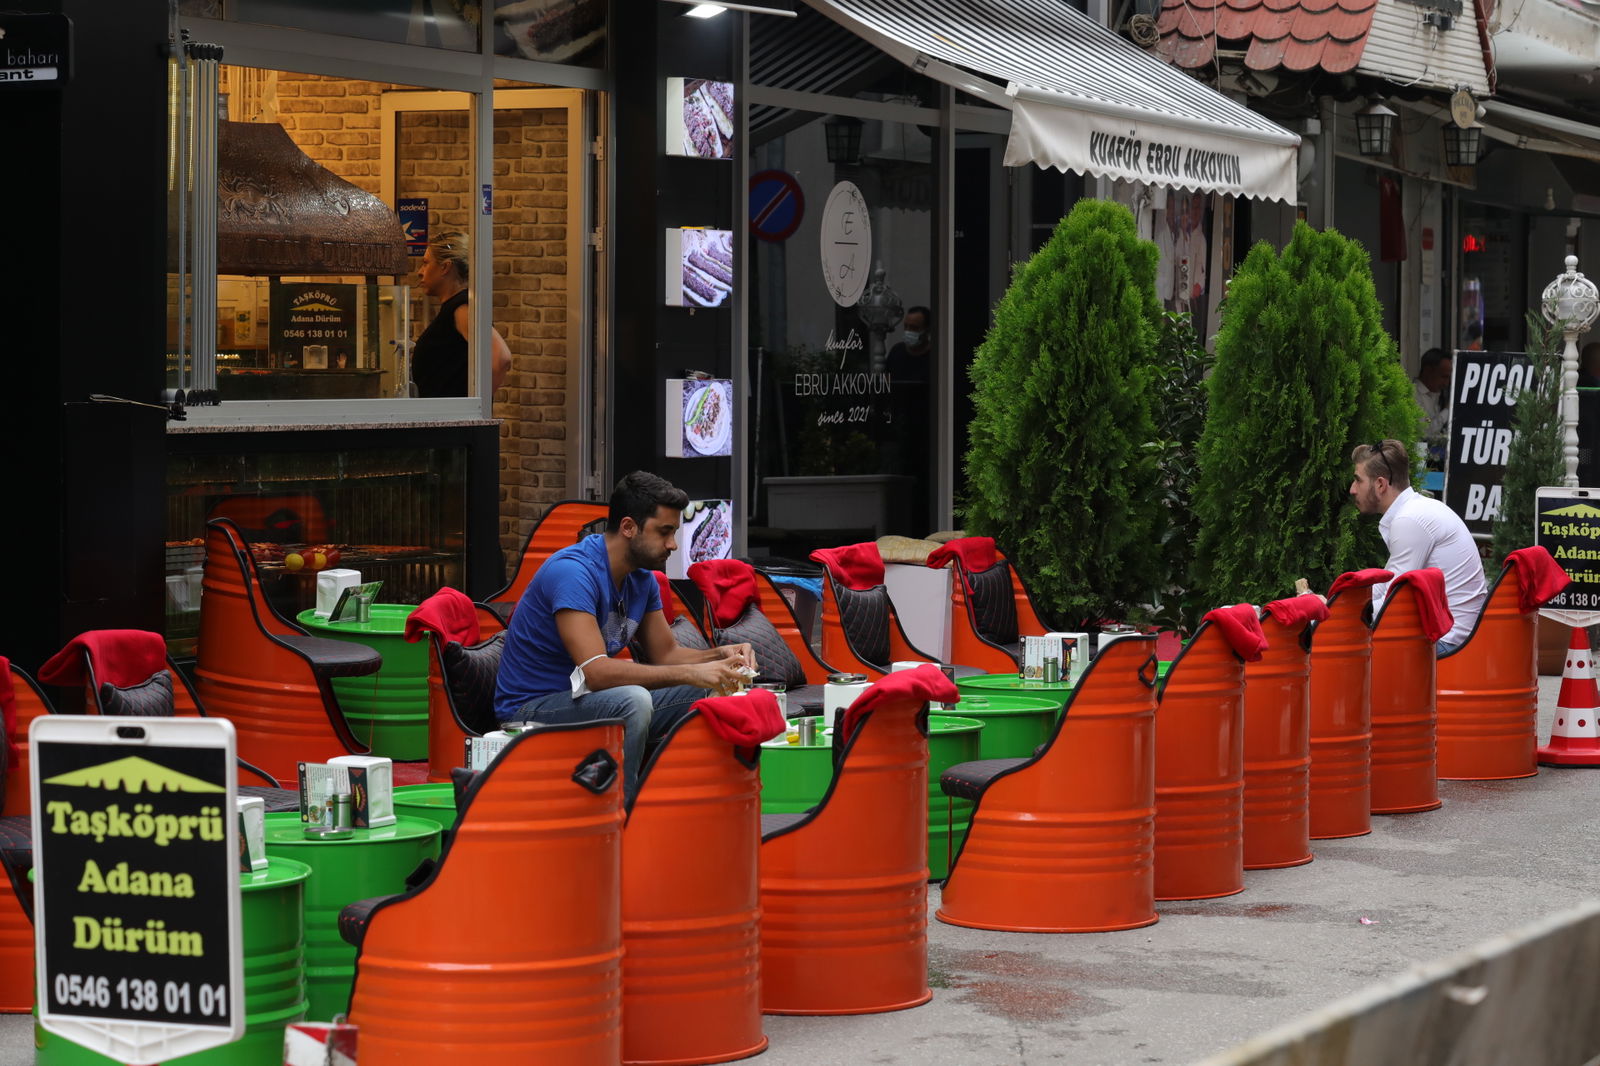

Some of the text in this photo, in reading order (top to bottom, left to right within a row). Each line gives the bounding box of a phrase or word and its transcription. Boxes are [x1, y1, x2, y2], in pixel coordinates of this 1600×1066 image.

[1090, 130, 1242, 185] KUAFÖR EBRU AKKOYUN
[293, 290, 337, 306] TAŞKÖPRÜ
[284, 330, 347, 338] 0546 138 01 01
[291, 314, 341, 323] Adana Dürüm
[795, 372, 891, 396] EBRU AKKOYUN
[817, 406, 870, 427] since 2021
[1465, 484, 1508, 523] BA
[1570, 593, 1588, 606] 138
[46, 800, 225, 846] Taşköprü
[77, 859, 195, 898] Adana
[72, 916, 204, 957] Dürüm
[55, 973, 226, 1017] 0546 138 01 01
